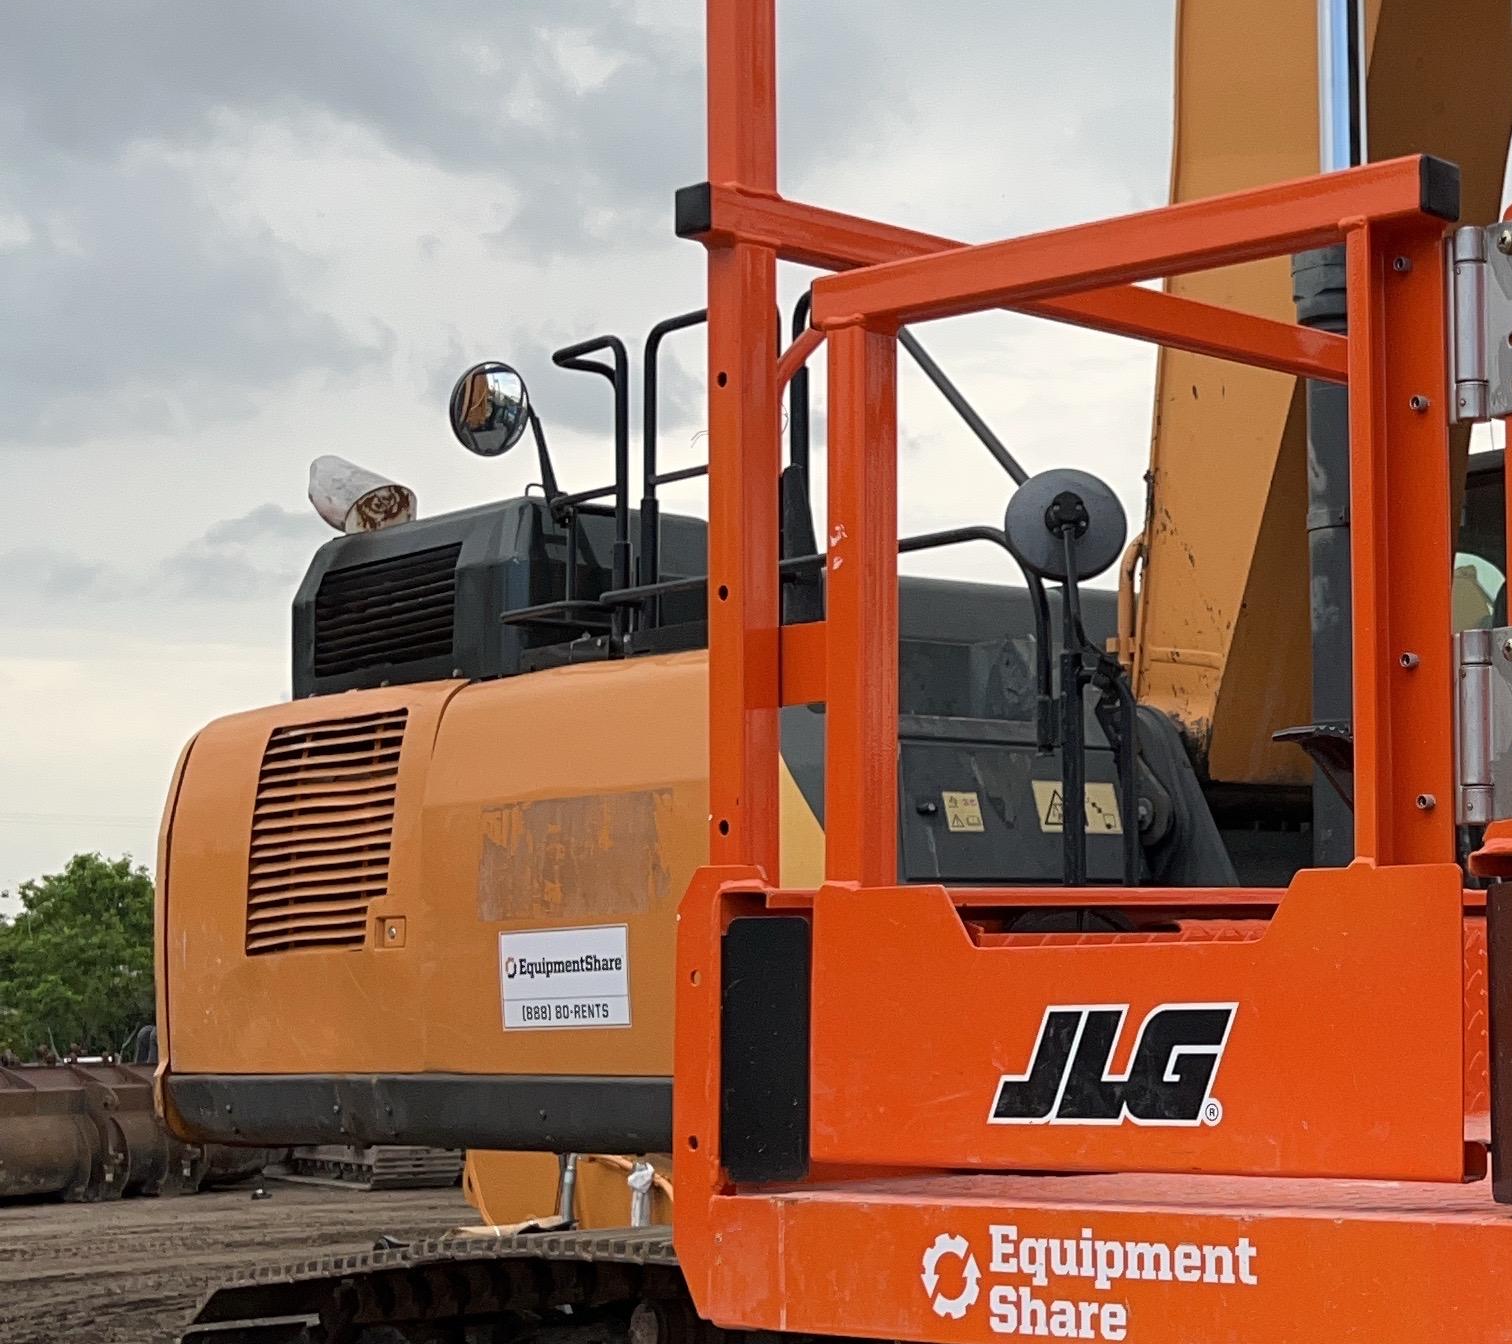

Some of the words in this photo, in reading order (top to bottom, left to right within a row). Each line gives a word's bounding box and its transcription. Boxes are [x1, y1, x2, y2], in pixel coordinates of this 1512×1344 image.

[519, 955, 622, 978] EquipmentShare
[522, 1004, 552, 1021] (888)
[989, 1224, 1258, 1290] Equipment
[989, 1285, 1129, 1341] Share
